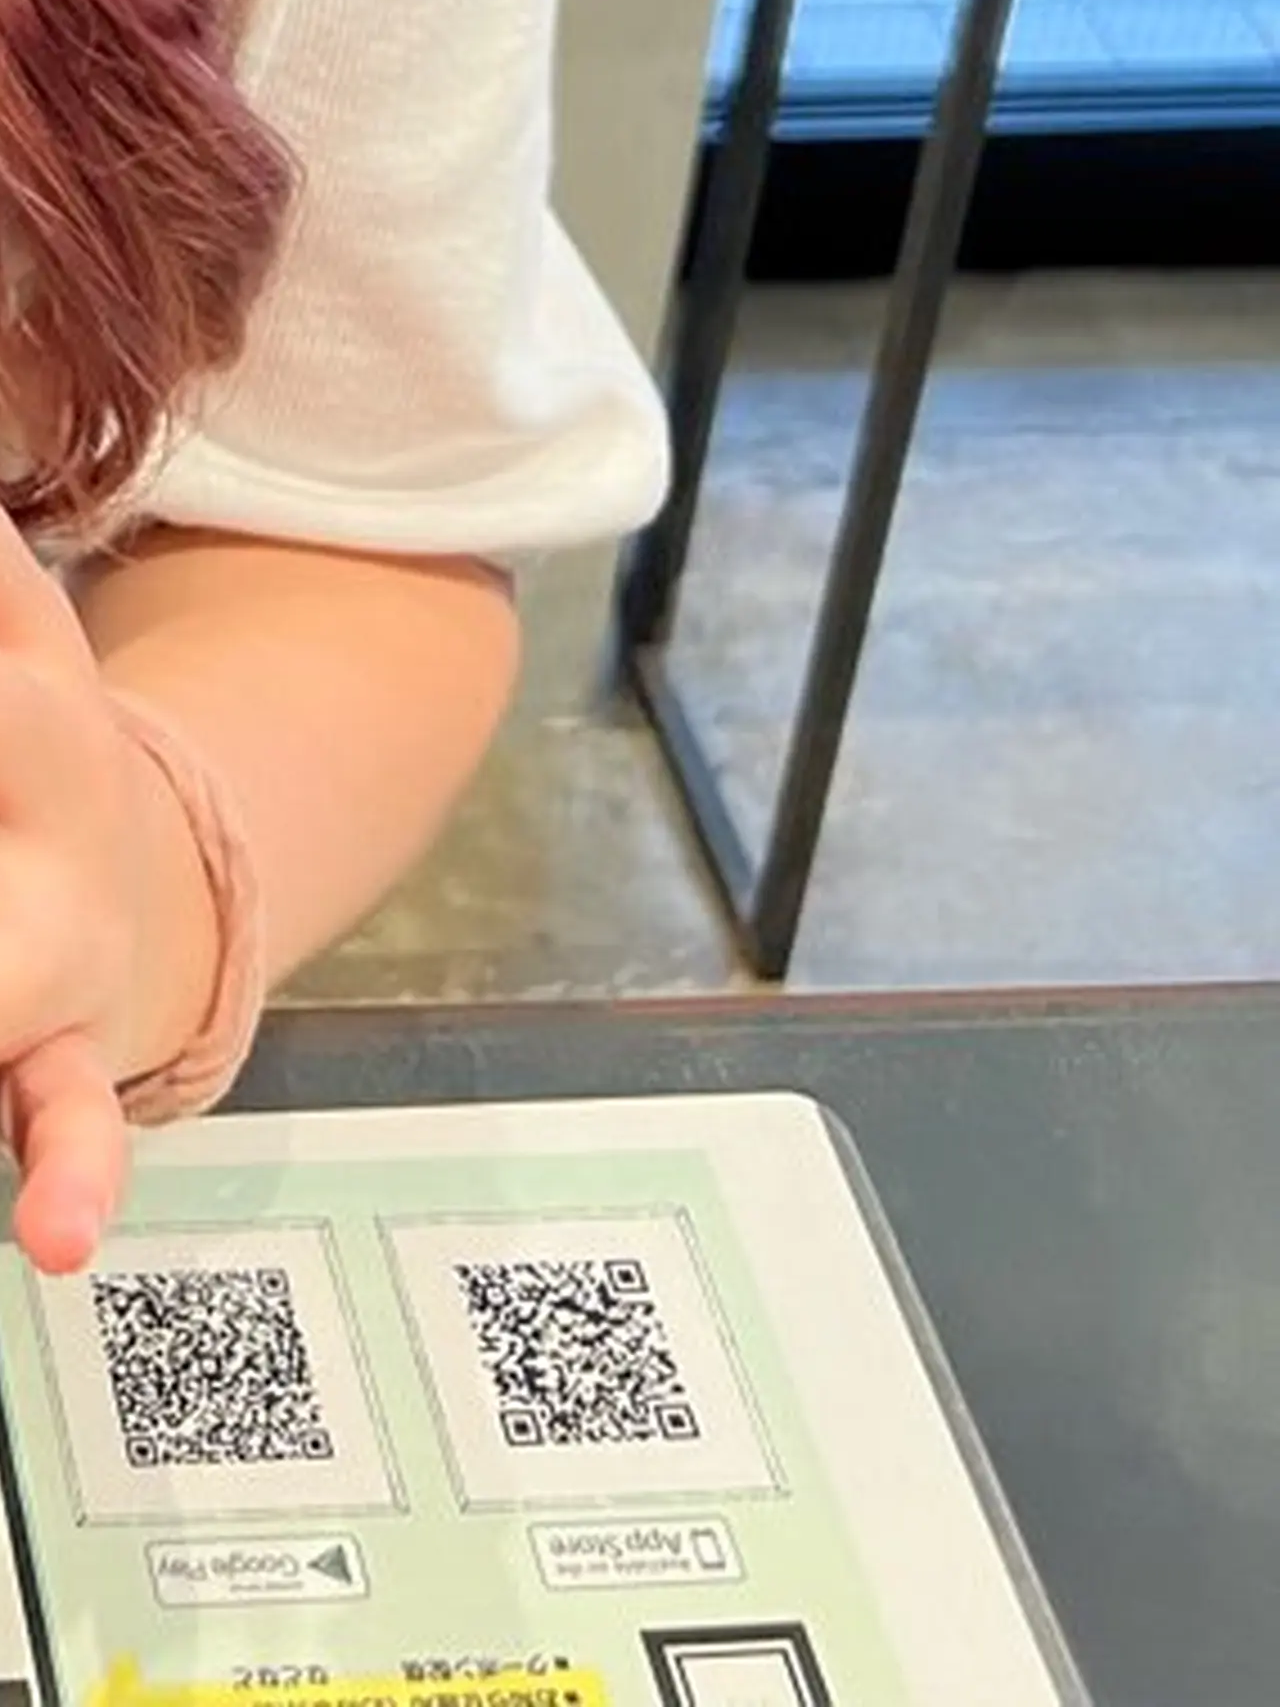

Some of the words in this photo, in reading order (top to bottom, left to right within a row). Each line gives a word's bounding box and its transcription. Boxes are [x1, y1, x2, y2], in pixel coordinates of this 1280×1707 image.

[549, 1534, 624, 1558] Store
[625, 1529, 682, 1556] App
[159, 1552, 209, 1581] Play
[210, 1551, 300, 1580] Google
